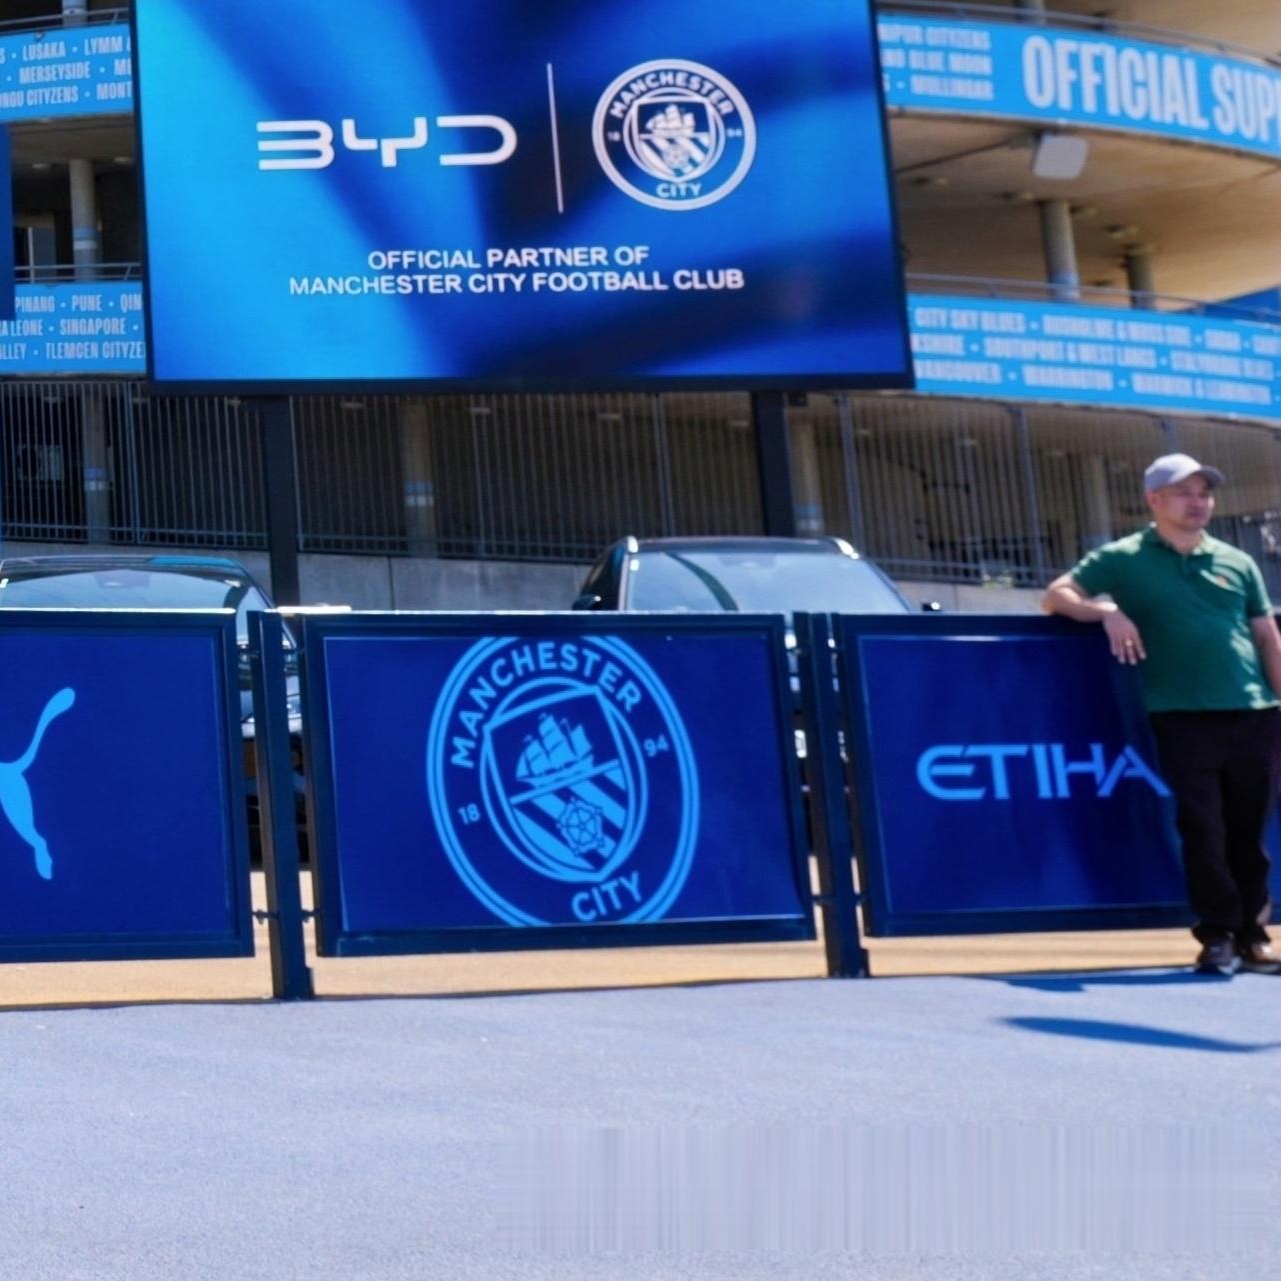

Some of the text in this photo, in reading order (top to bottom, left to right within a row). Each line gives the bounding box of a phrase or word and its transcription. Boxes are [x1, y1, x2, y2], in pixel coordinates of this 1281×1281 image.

[23, 40, 67, 61] LUSAKA
[19, 61, 91, 84] MERSEYSIDE
[1023, 35, 1209, 130] OFFICIAL
[27, 85, 79, 107] CITYZENS
[609, 71, 734, 118] MANCHESTER
[257, 114, 517, 170] BYD
[656, 183, 702, 198] CITY
[368, 246, 649, 270] OFFICIAL PARTNER OF
[290, 269, 744, 295] MANCHESTER CITY FOOTBALL CLUB
[71, 294, 102, 312] PUNE
[60, 317, 126, 336] SINGAPORE
[102, 340, 145, 358] CITYZE
[451, 642, 642, 768] MANCHESTER
[644, 734, 669, 757] 94
[917, 742, 1172, 800] ETIHA
[458, 803, 480, 825] 18
[571, 871, 642, 921] CITY
